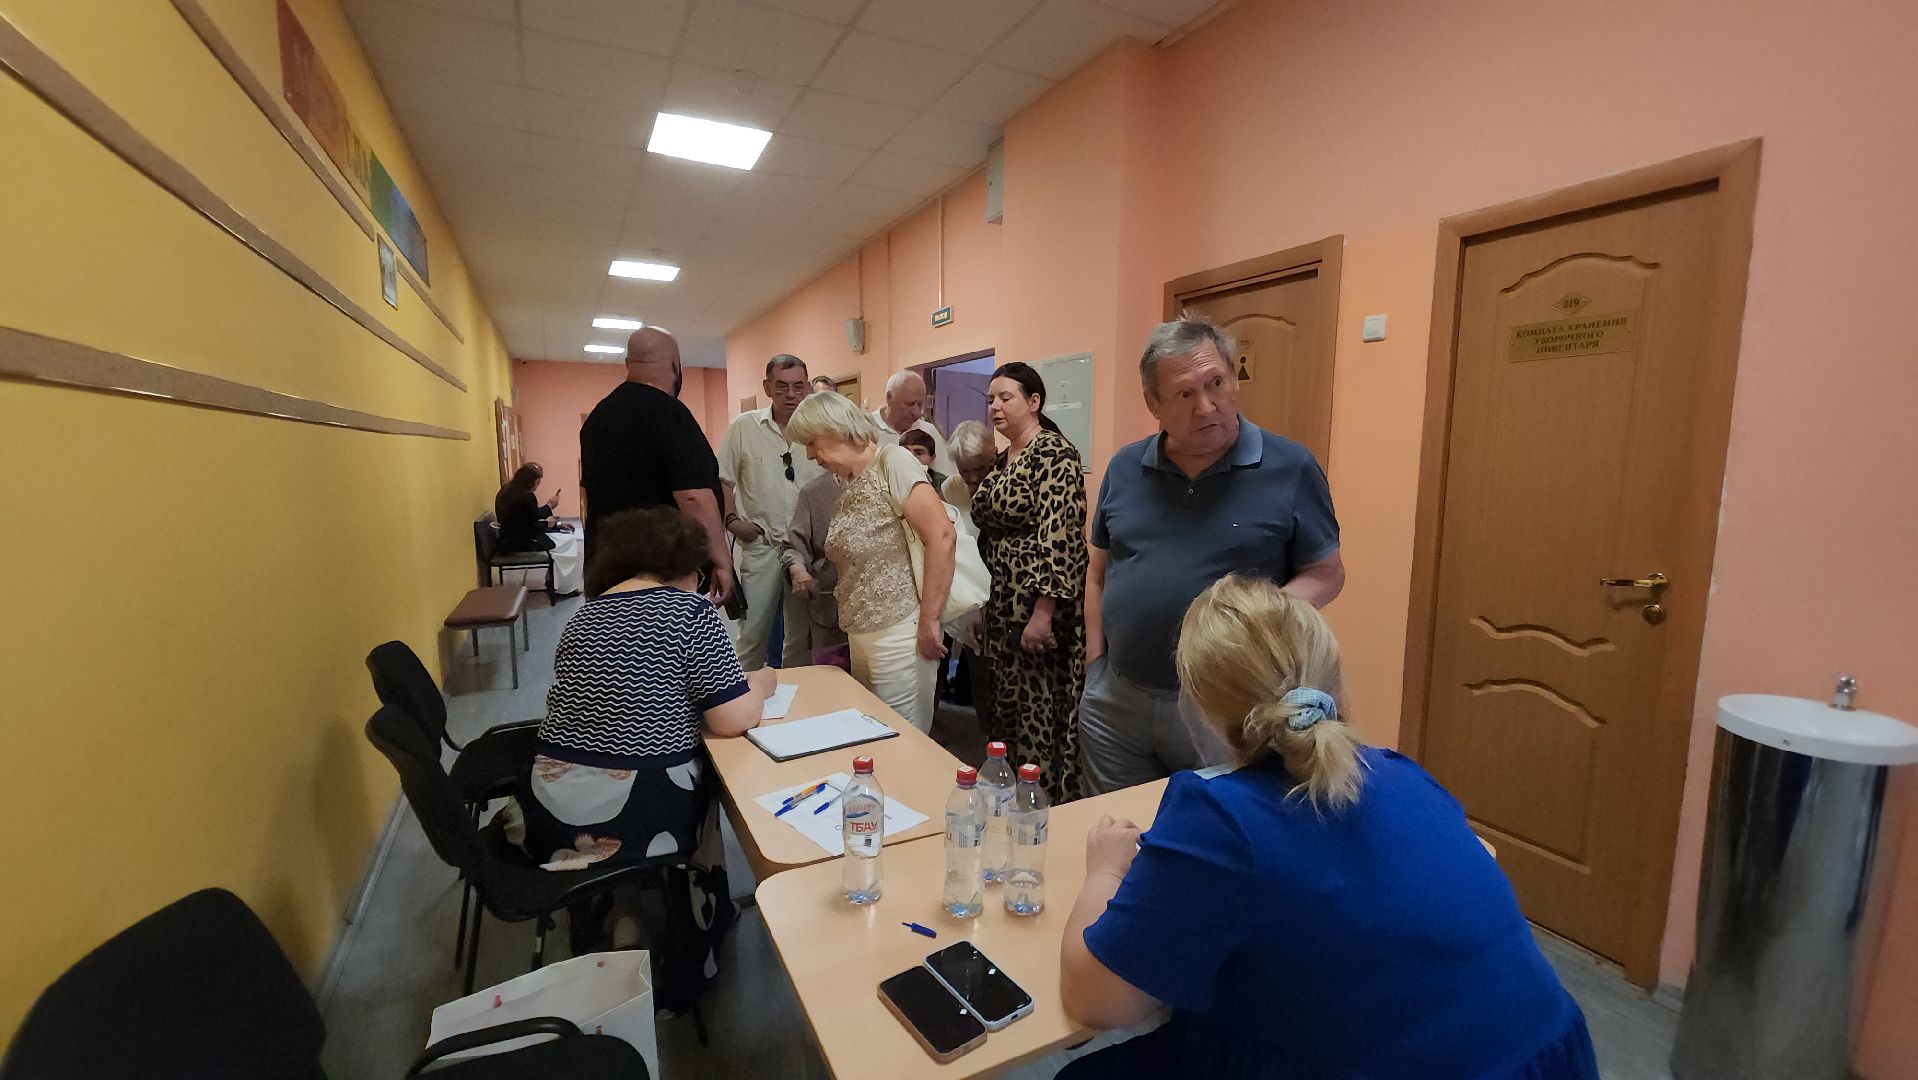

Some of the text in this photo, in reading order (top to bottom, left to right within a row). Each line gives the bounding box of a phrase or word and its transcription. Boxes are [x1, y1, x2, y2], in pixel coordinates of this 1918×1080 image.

[1562, 298, 1580, 309] 219
[1516, 317, 1628, 338] КОМНАТА ХРАНЕНИЯ
[1534, 331, 1604, 345] УБОРОЧНОГО
[1536, 340, 1599, 353] ИНВЕНТАРЯ
